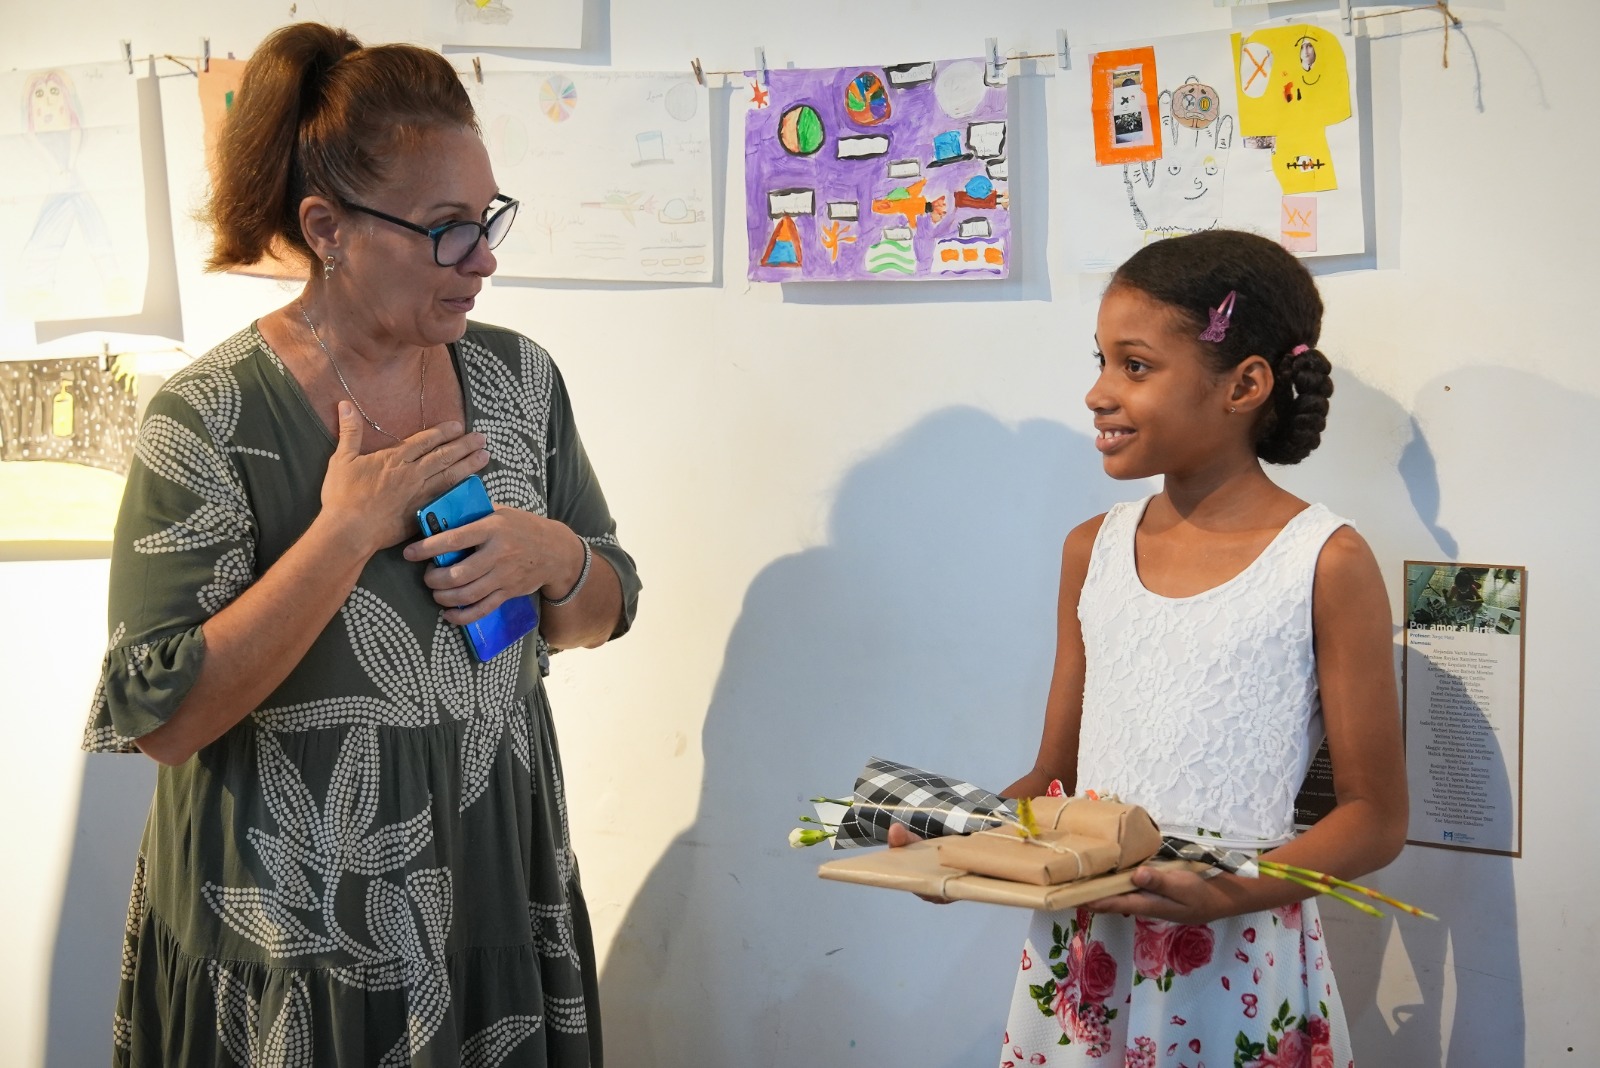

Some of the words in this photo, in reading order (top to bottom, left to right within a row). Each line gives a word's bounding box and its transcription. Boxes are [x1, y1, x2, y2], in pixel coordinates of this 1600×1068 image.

[1410, 621, 1427, 630] Por
[1430, 624, 1458, 632] amor
[1473, 625, 1494, 635] arte
